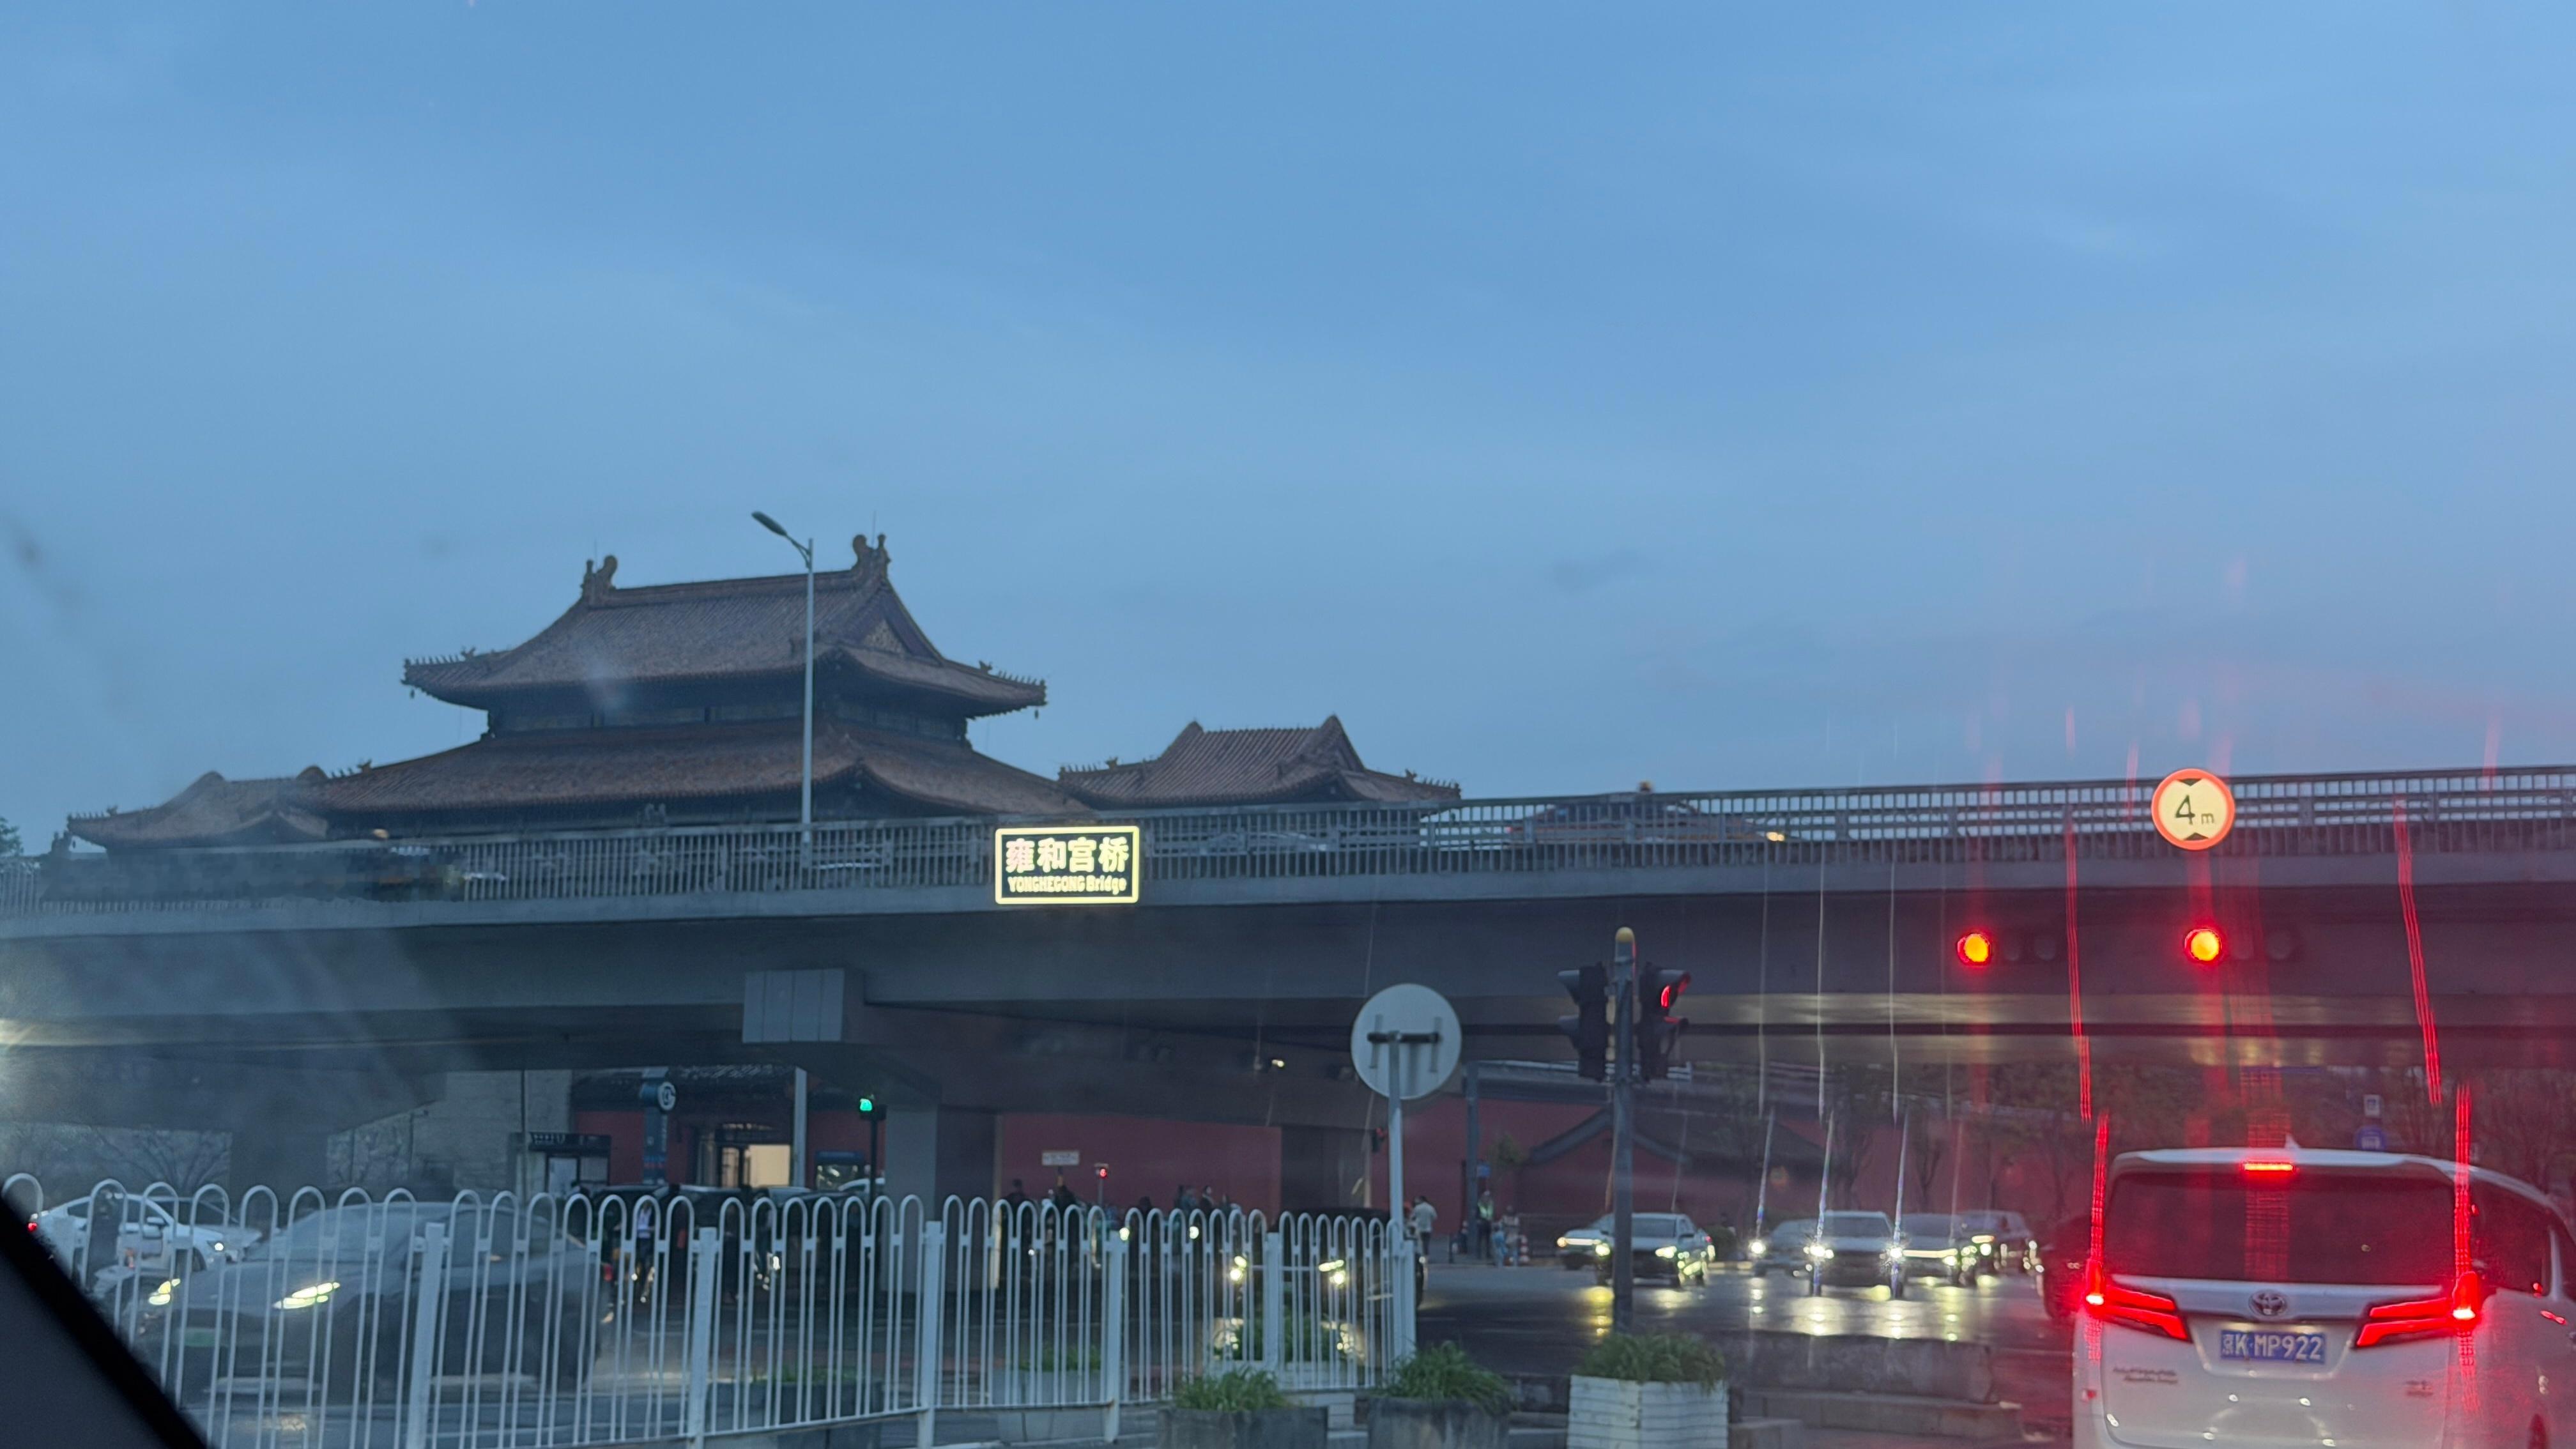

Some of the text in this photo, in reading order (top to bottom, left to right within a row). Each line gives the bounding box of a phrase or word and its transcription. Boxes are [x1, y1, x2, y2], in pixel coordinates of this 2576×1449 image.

[1006, 836, 1129, 873] 雍和宫桥
[1008, 875, 1127, 895] YONGHEGONG Bridge
